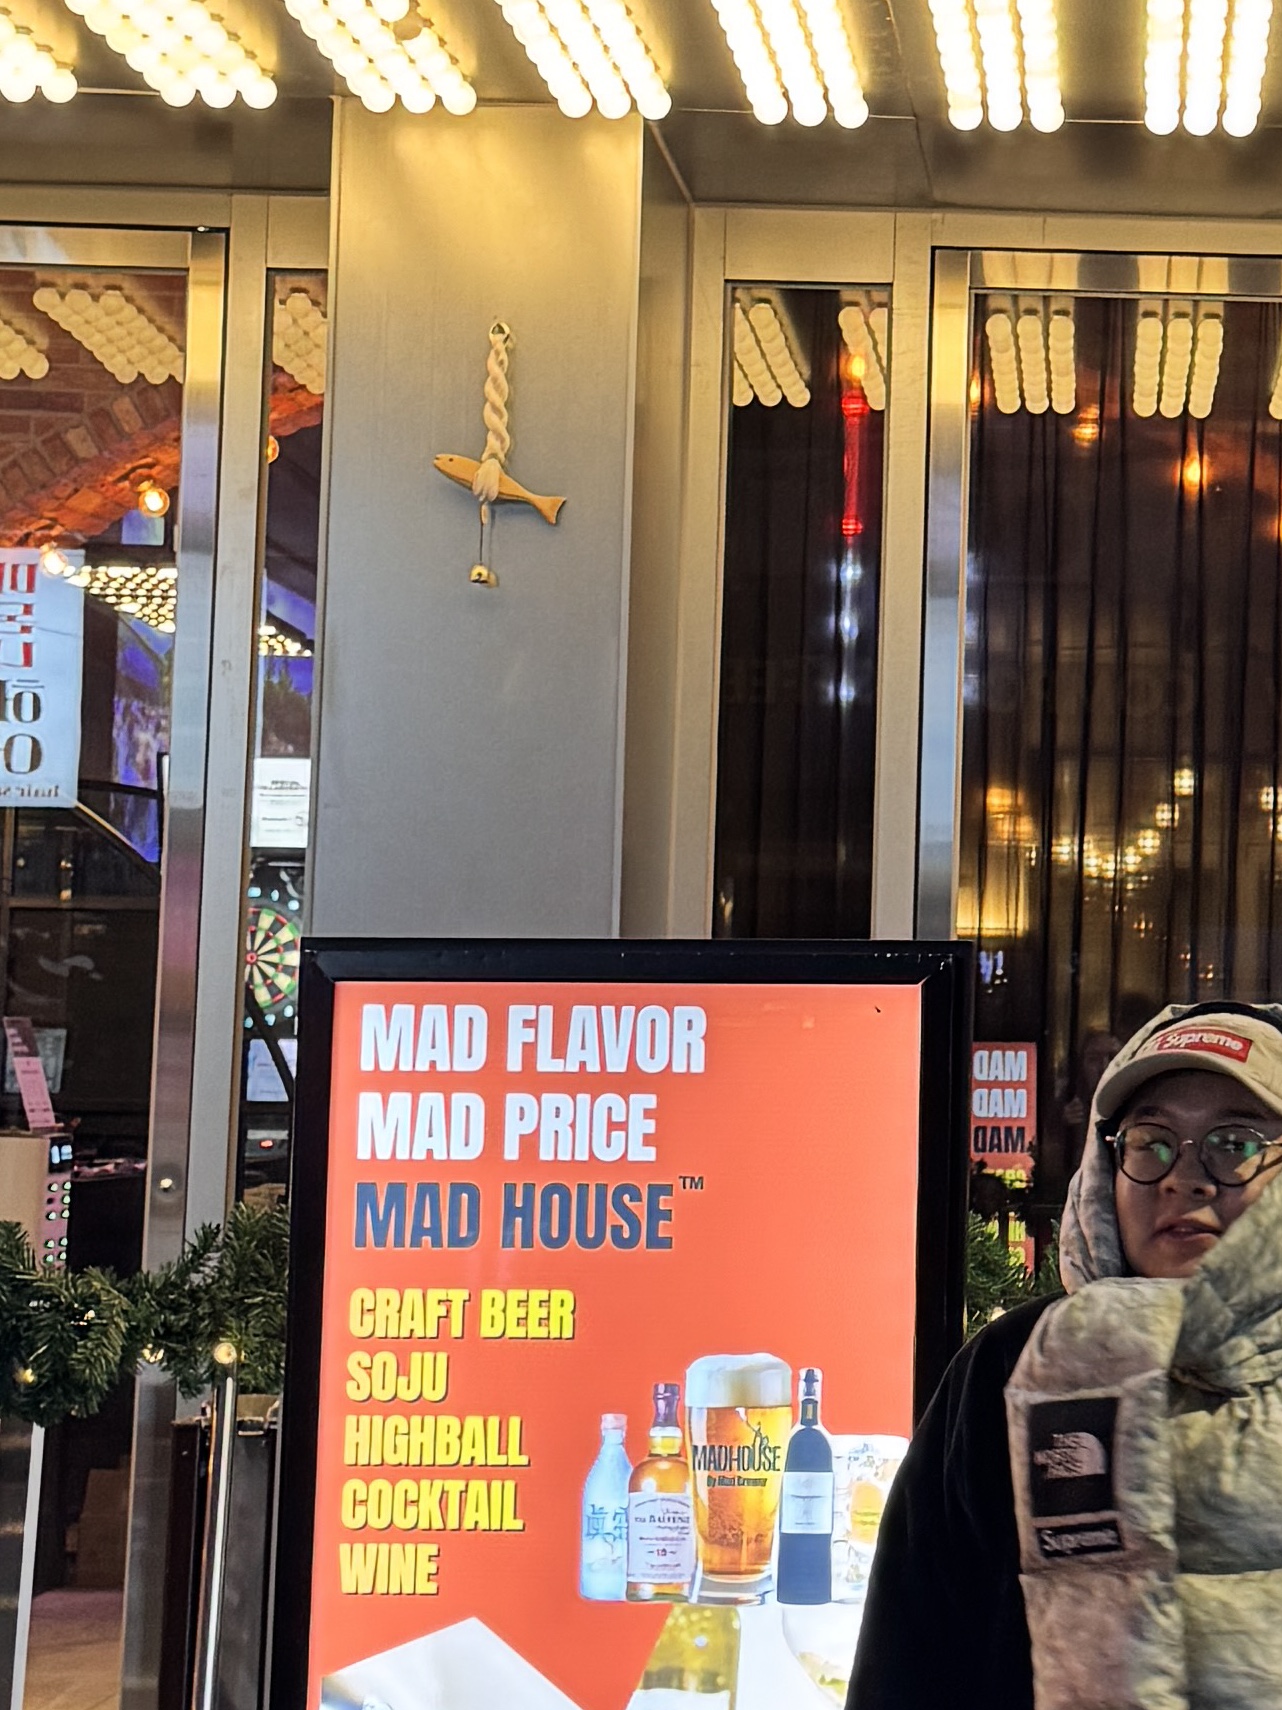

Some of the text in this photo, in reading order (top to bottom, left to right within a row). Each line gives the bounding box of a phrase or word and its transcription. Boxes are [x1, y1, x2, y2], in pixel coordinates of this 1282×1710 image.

[359, 1003, 707, 1074] MAD FLAVOR
[1163, 1033, 1243, 1051] Supreme
[355, 1092, 657, 1162] MAD PRICE
[353, 1181, 481, 1249] MAD
[501, 1182, 674, 1250] HOUSE
[349, 1288, 575, 1340] CRAFT BEER
[346, 1352, 449, 1403] SOJU
[343, 1415, 530, 1467] HIGHBALL
[692, 1443, 781, 1472] MADHOUSE
[341, 1479, 525, 1531] COCKTAIL
[340, 1542, 439, 1596] WINE
